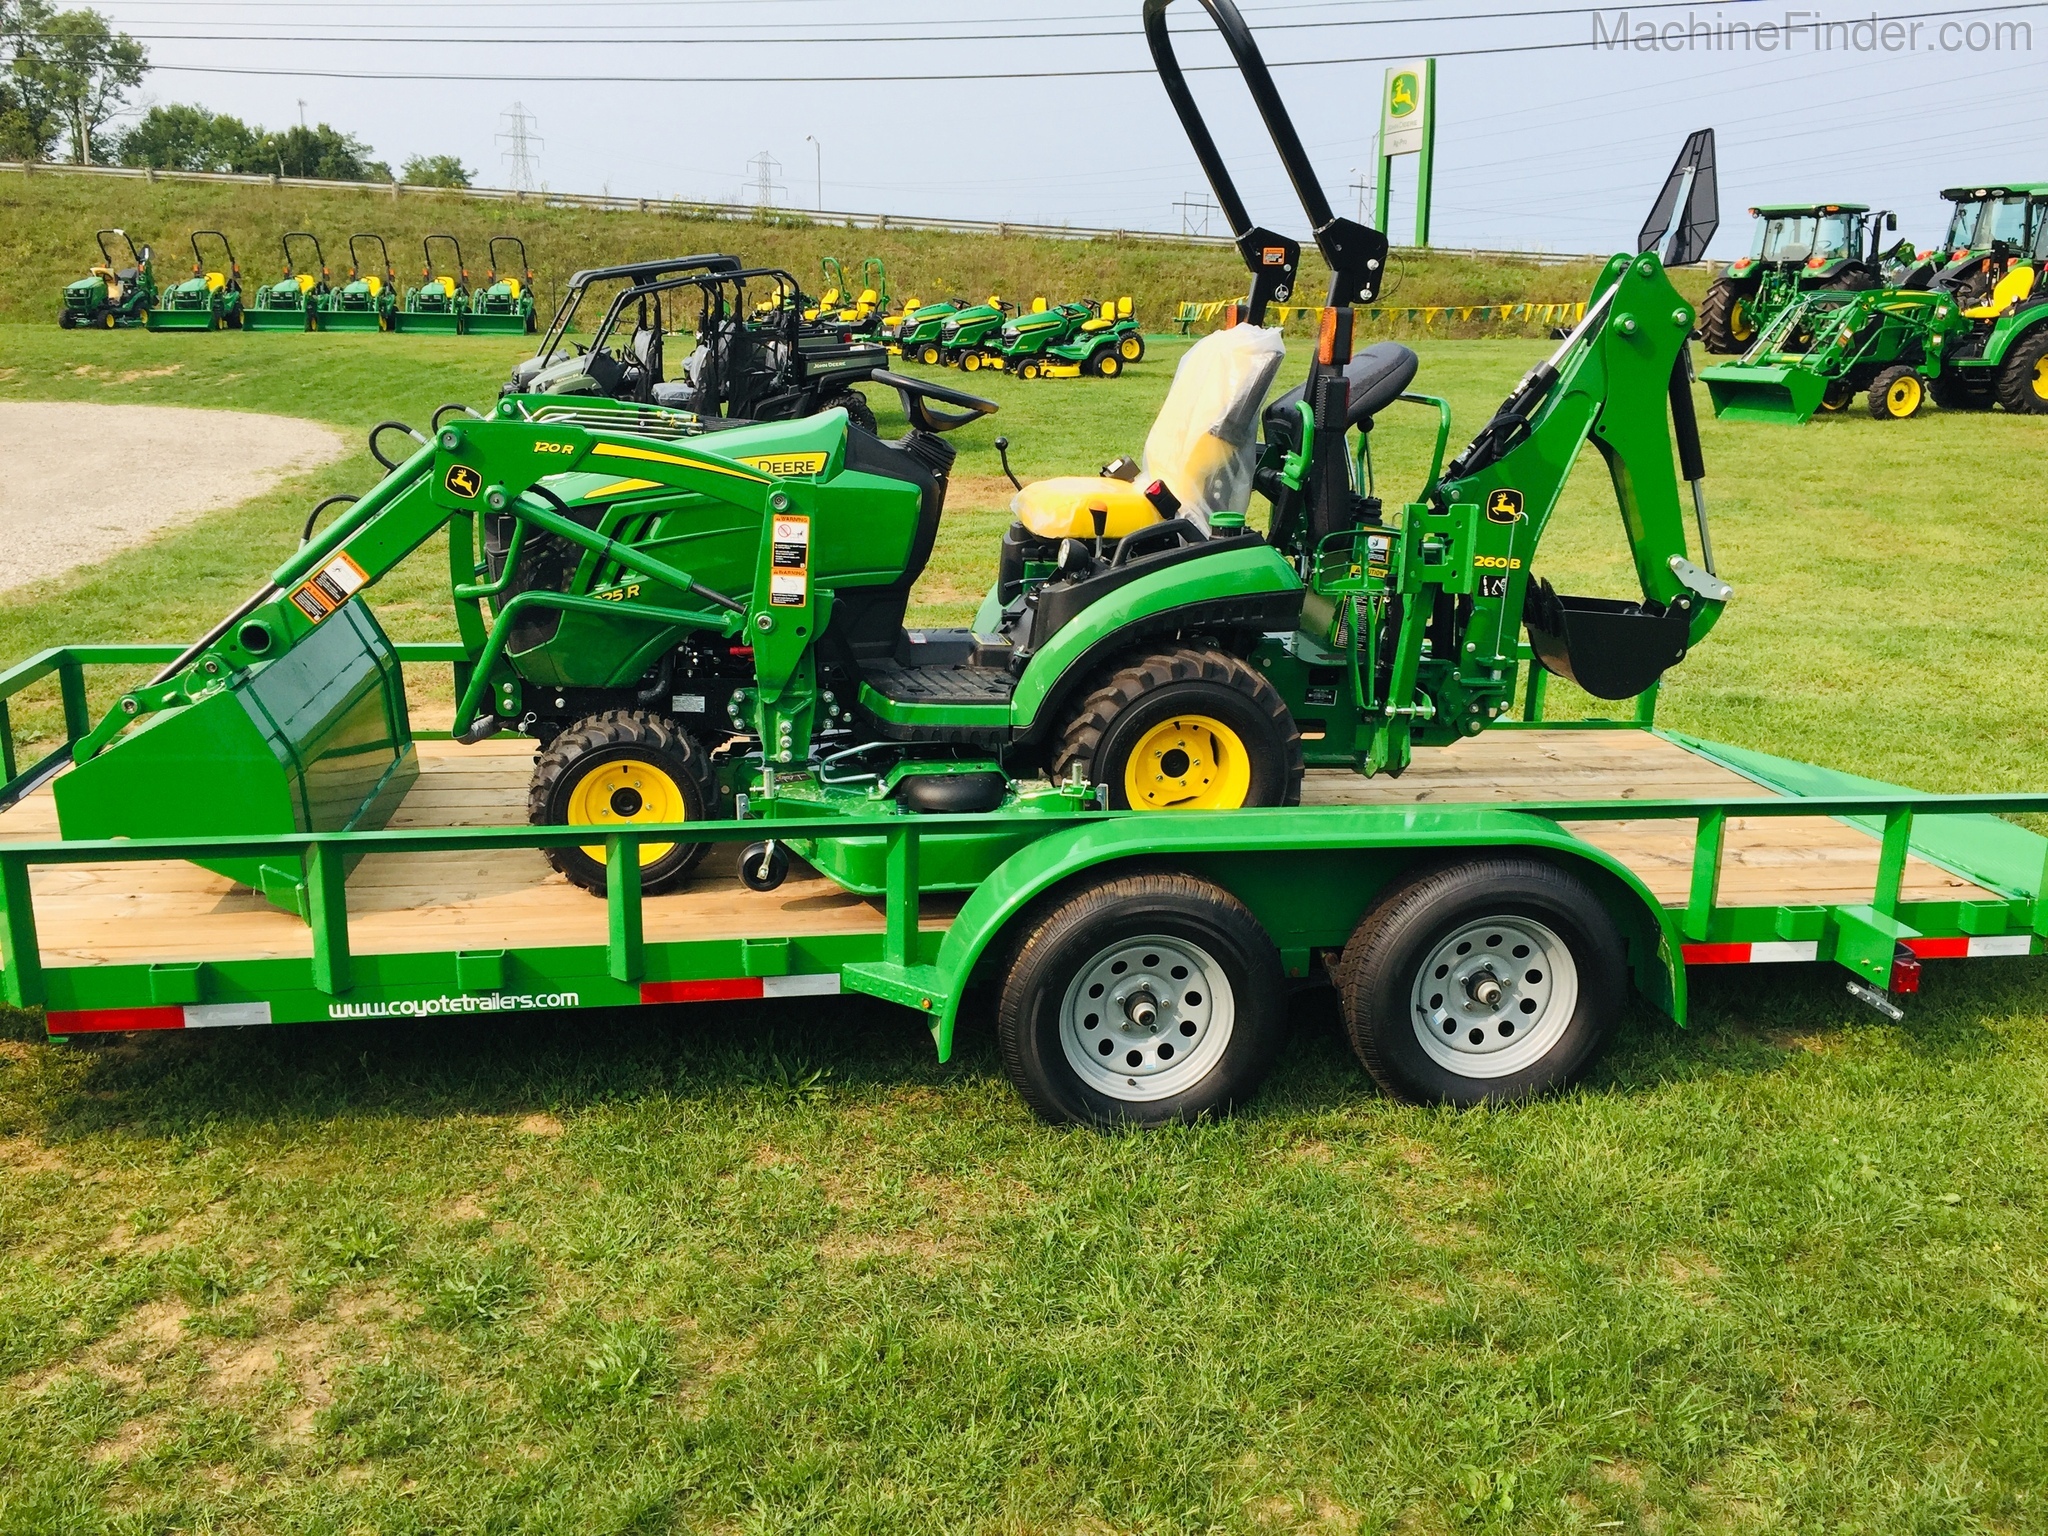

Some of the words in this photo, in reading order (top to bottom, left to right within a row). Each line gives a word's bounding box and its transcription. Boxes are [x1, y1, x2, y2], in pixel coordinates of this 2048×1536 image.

[533, 441, 561, 453] 120
[561, 444, 574, 455] R
[758, 460, 816, 473] DEERE
[1473, 555, 1508, 568] 260
[1509, 558, 1521, 569] B
[627, 584, 640, 598] R
[328, 992, 580, 1018] www.coyotetrailers.com
